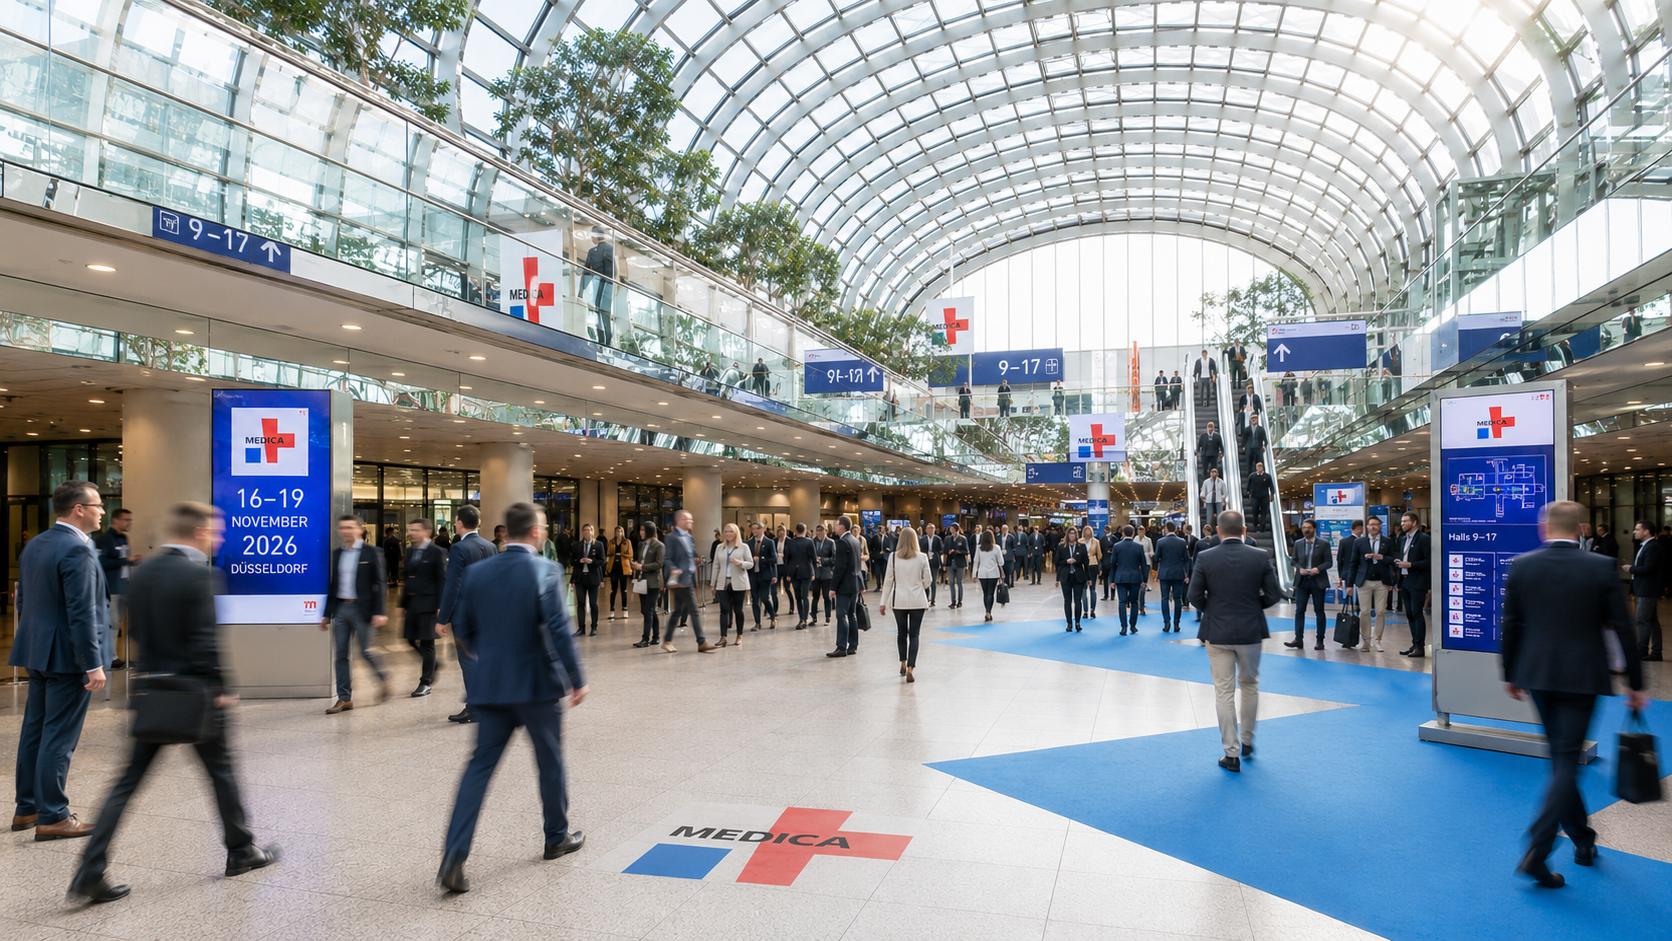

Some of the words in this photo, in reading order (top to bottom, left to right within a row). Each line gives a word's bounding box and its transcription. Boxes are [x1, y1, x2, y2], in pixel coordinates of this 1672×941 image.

[188, 218, 249, 253] 9–17
[509, 288, 544, 300] MEDCA
[998, 358, 1041, 376] 9–17
[1476, 419, 1507, 427] MEDICA
[245, 436, 284, 445] MEDICA
[1077, 437, 1108, 445] MEDICA
[237, 488, 304, 508] 16–19
[231, 516, 308, 528] NOVEMBER
[1448, 532, 1471, 541] Halls
[242, 534, 297, 555] 2026
[231, 561, 308, 574] DÜSSELDORF
[669, 825, 850, 850] MEDICA
